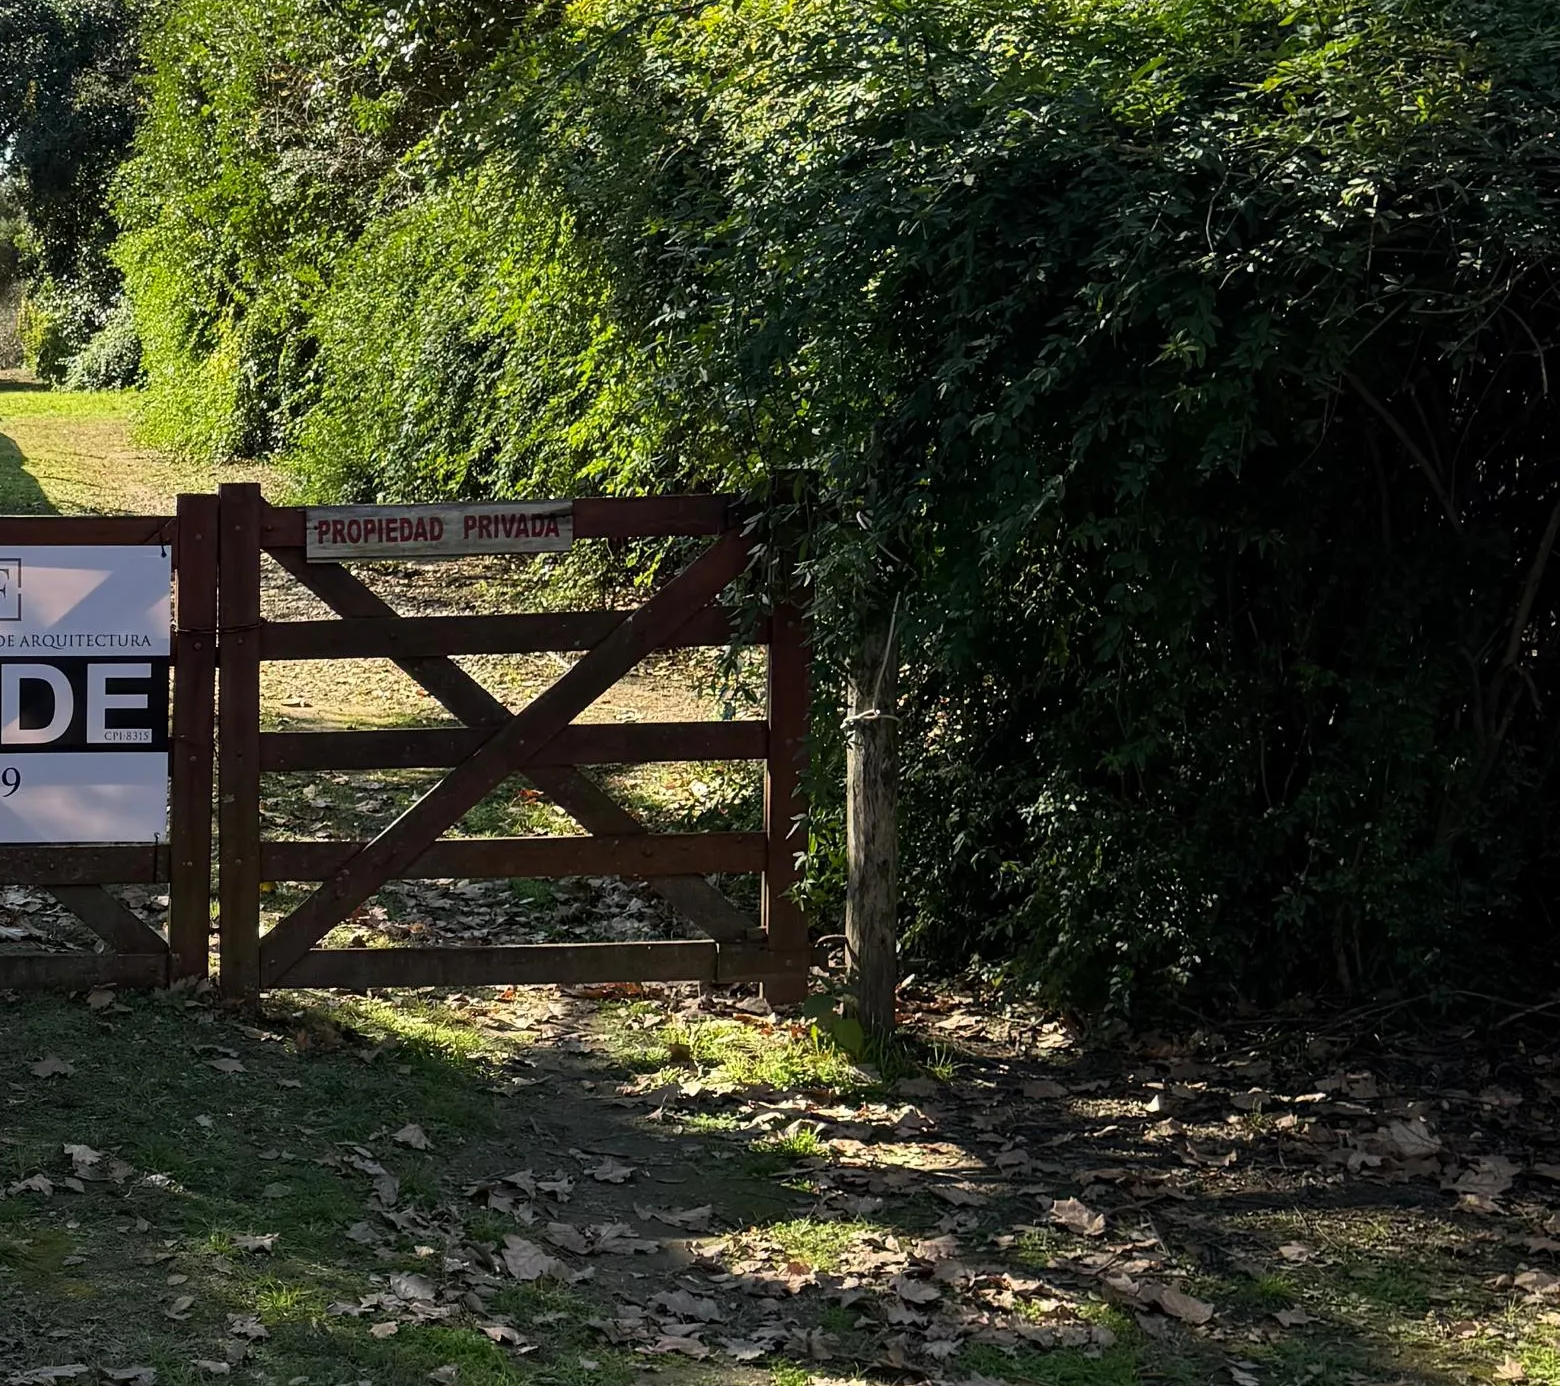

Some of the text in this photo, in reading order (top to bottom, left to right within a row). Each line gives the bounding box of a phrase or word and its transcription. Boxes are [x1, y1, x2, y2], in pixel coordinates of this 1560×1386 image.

[317, 513, 560, 545] PROPIEDAD PRIVADA
[19, 633, 152, 650] ARQUITECTURA
